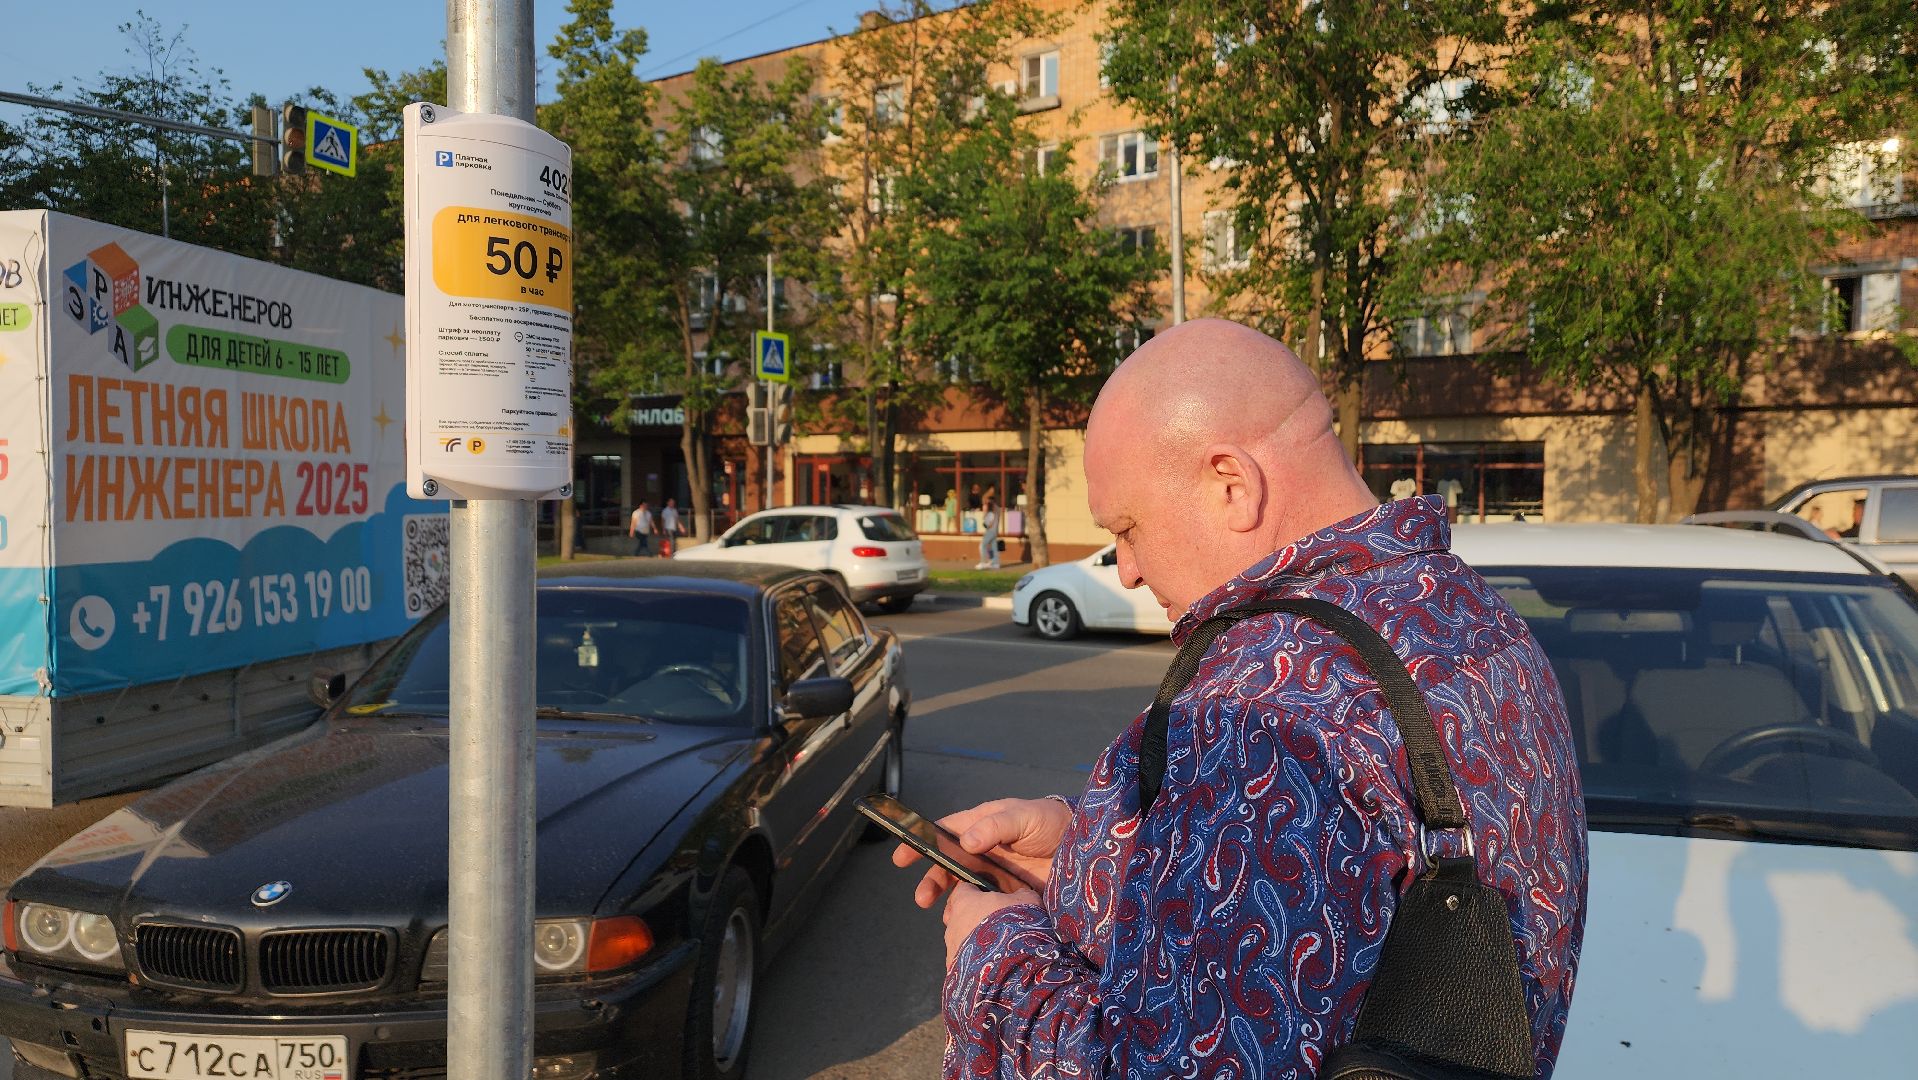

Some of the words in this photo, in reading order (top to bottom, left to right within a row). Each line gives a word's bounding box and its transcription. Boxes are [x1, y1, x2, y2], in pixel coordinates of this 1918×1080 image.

[455, 154, 488, 163] Платная
[455, 161, 492, 171] парковка
[457, 214, 480, 224] для
[484, 216, 538, 232] легкового
[486, 236, 538, 280] 50
[145, 275, 293, 329] ИНЖЕНЕРОВ
[521, 286, 527, 294] в
[529, 287, 545, 297] час
[186, 332, 221, 362] ДЛЯ
[226, 338, 271, 369] ДЕТЕЙ
[276, 350, 283, 369] 6
[299, 351, 312, 374] 15
[316, 354, 339, 377] ЛЕТ
[66, 374, 229, 449] ЛЕТНЯЯ
[240, 391, 352, 454] ШКОЛА
[65, 454, 286, 522] ИНЖЕНЕРА
[295, 461, 369, 517] 2025
[132, 585, 171, 641] +7
[183, 578, 242, 637] 926
[249, 573, 299, 627] 153
[304, 569, 333, 618] 19
[340, 566, 371, 612] 00
[138, 1040, 273, 1078] С712СА
[280, 1042, 336, 1069] 750
[294, 1069, 322, 1079] RUS
